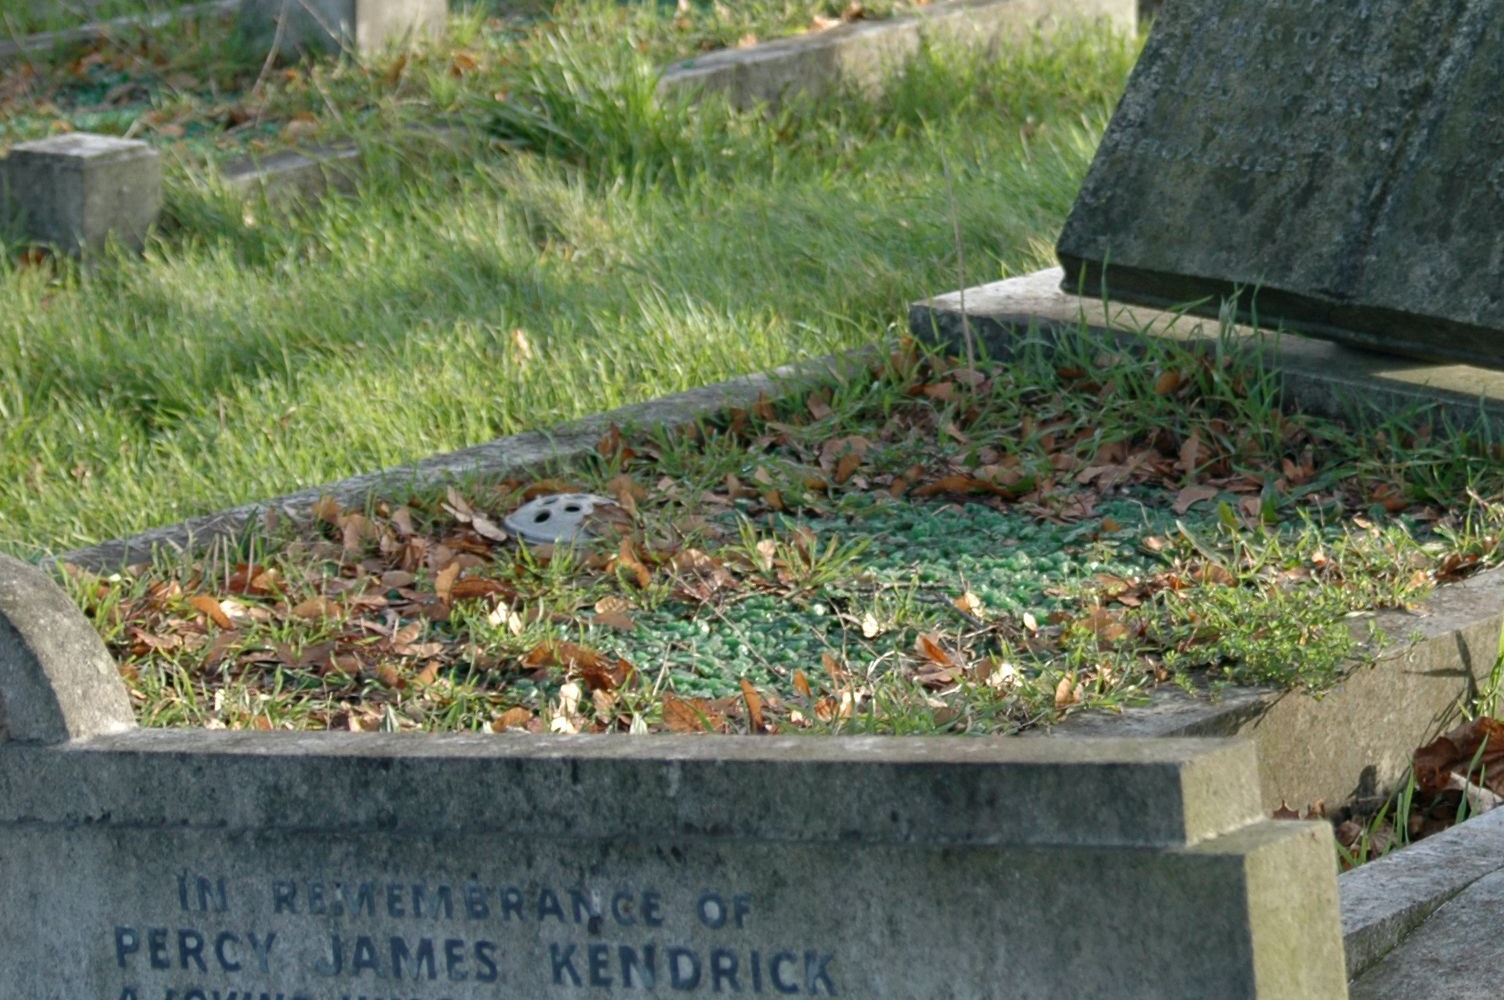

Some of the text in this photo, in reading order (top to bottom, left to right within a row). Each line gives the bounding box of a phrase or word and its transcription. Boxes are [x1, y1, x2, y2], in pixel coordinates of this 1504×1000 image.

[177, 872, 753, 931] IN REMEMBRANCE OF
[114, 924, 838, 998] PERCY JAMES KENDRICK
